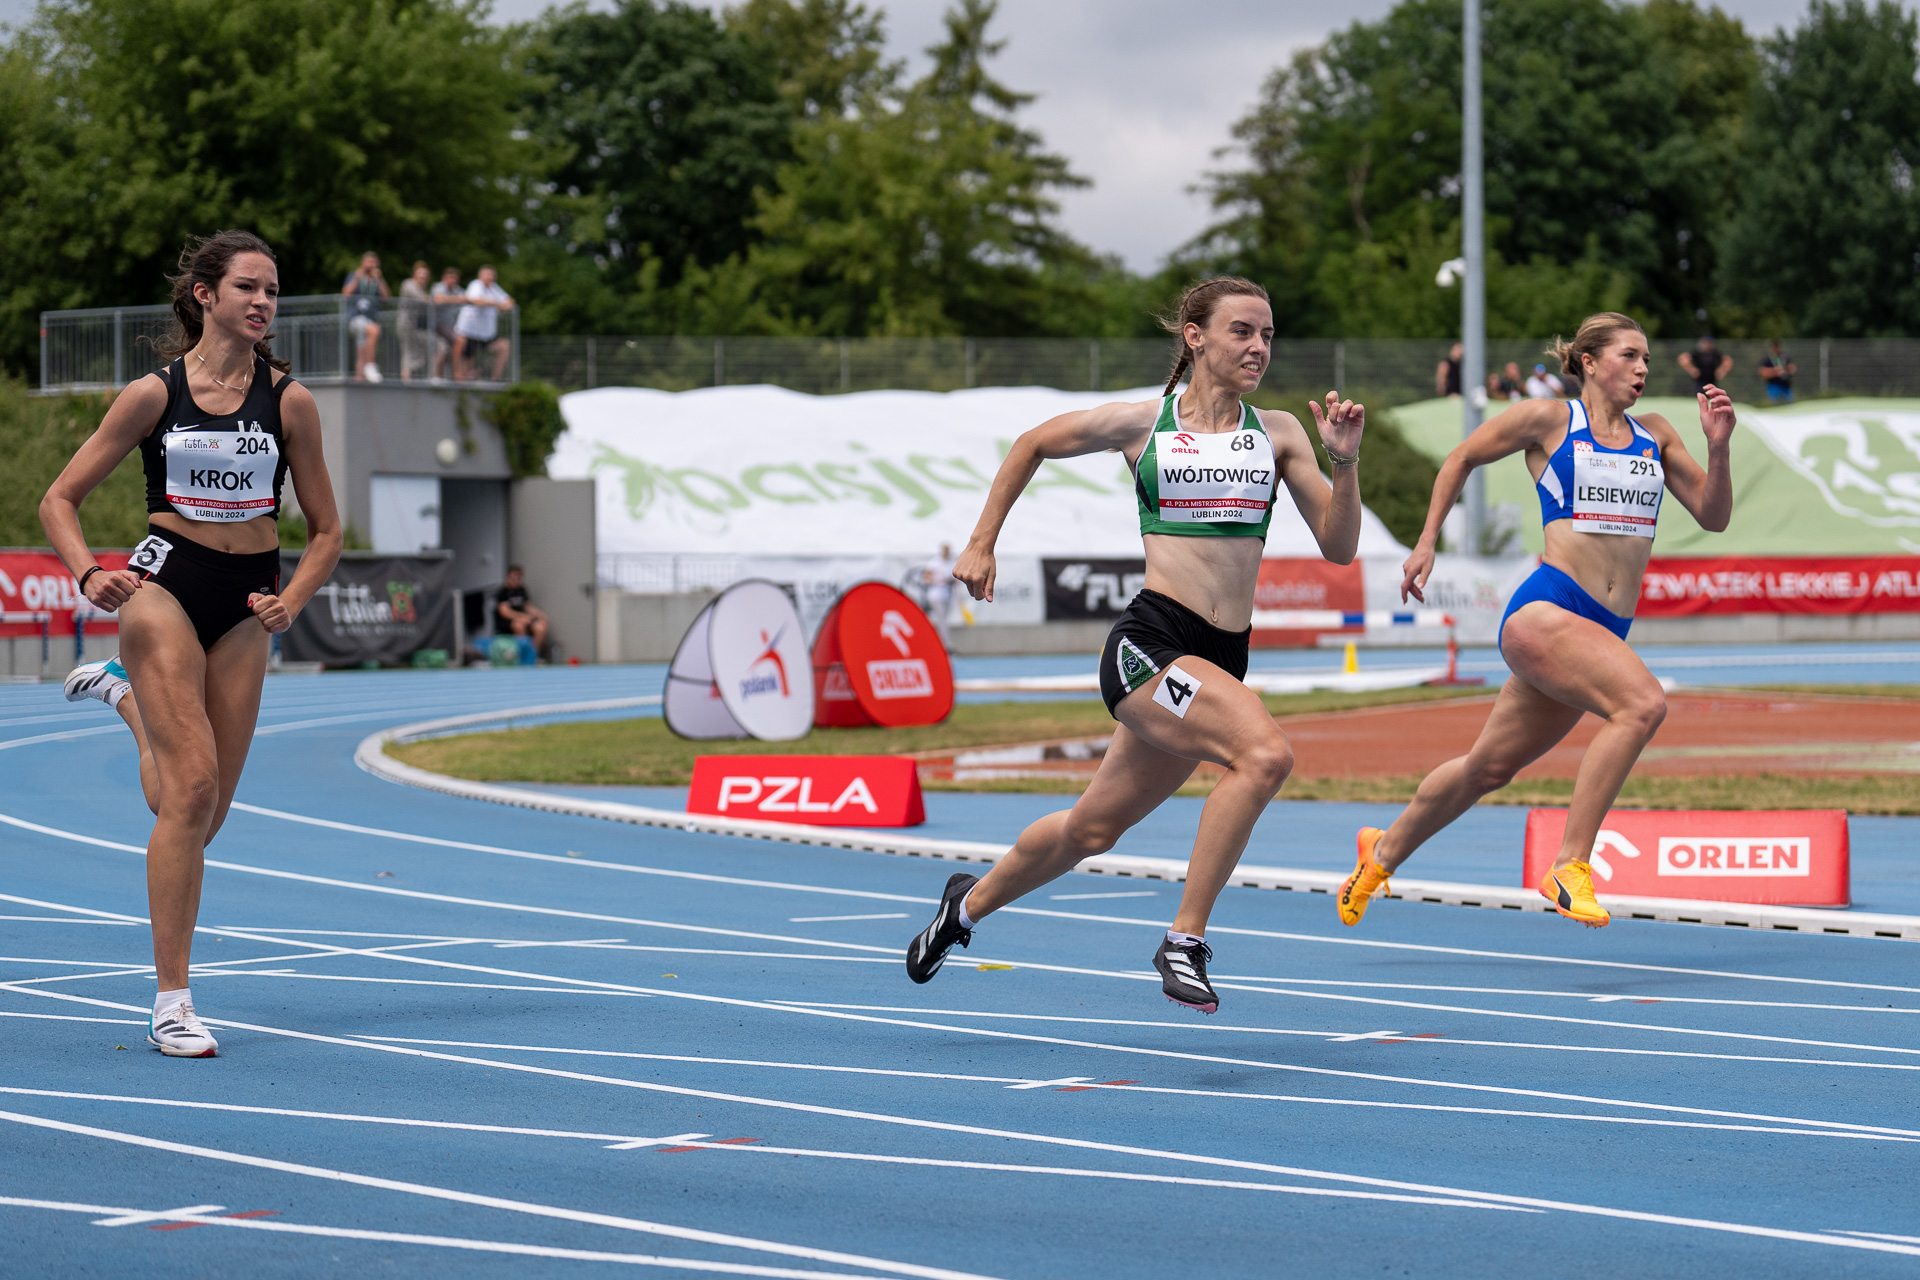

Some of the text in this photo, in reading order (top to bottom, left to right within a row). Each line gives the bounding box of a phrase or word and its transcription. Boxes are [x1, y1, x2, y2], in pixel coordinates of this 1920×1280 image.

[235, 437, 270, 455] 204
[1171, 447, 1200, 455] ORLEN
[1230, 434, 1255, 451] 68
[1163, 465, 1271, 485] WÓJTOWICZ
[1630, 460, 1657, 477] 291
[190, 469, 255, 491] KROK
[195, 499, 238, 508] MISTRZOSTWA
[1236, 500, 1255, 508] POLSKI
[1578, 486, 1659, 507] LESIEWICZ
[195, 509, 246, 519] LUBLIN 2024
[1191, 510, 1243, 519] LUBLIN 2024
[1599, 523, 1621, 531] LUBLIN
[136, 538, 164, 566] 5
[1645, 571, 1764, 601] ZWIĄZEK
[1765, 571, 1869, 599] LEKKIEJ
[873, 667, 926, 691] ORLEN
[1165, 675, 1193, 706] 4
[717, 776, 879, 813] PZLA
[1667, 843, 1800, 870] ORLEN
